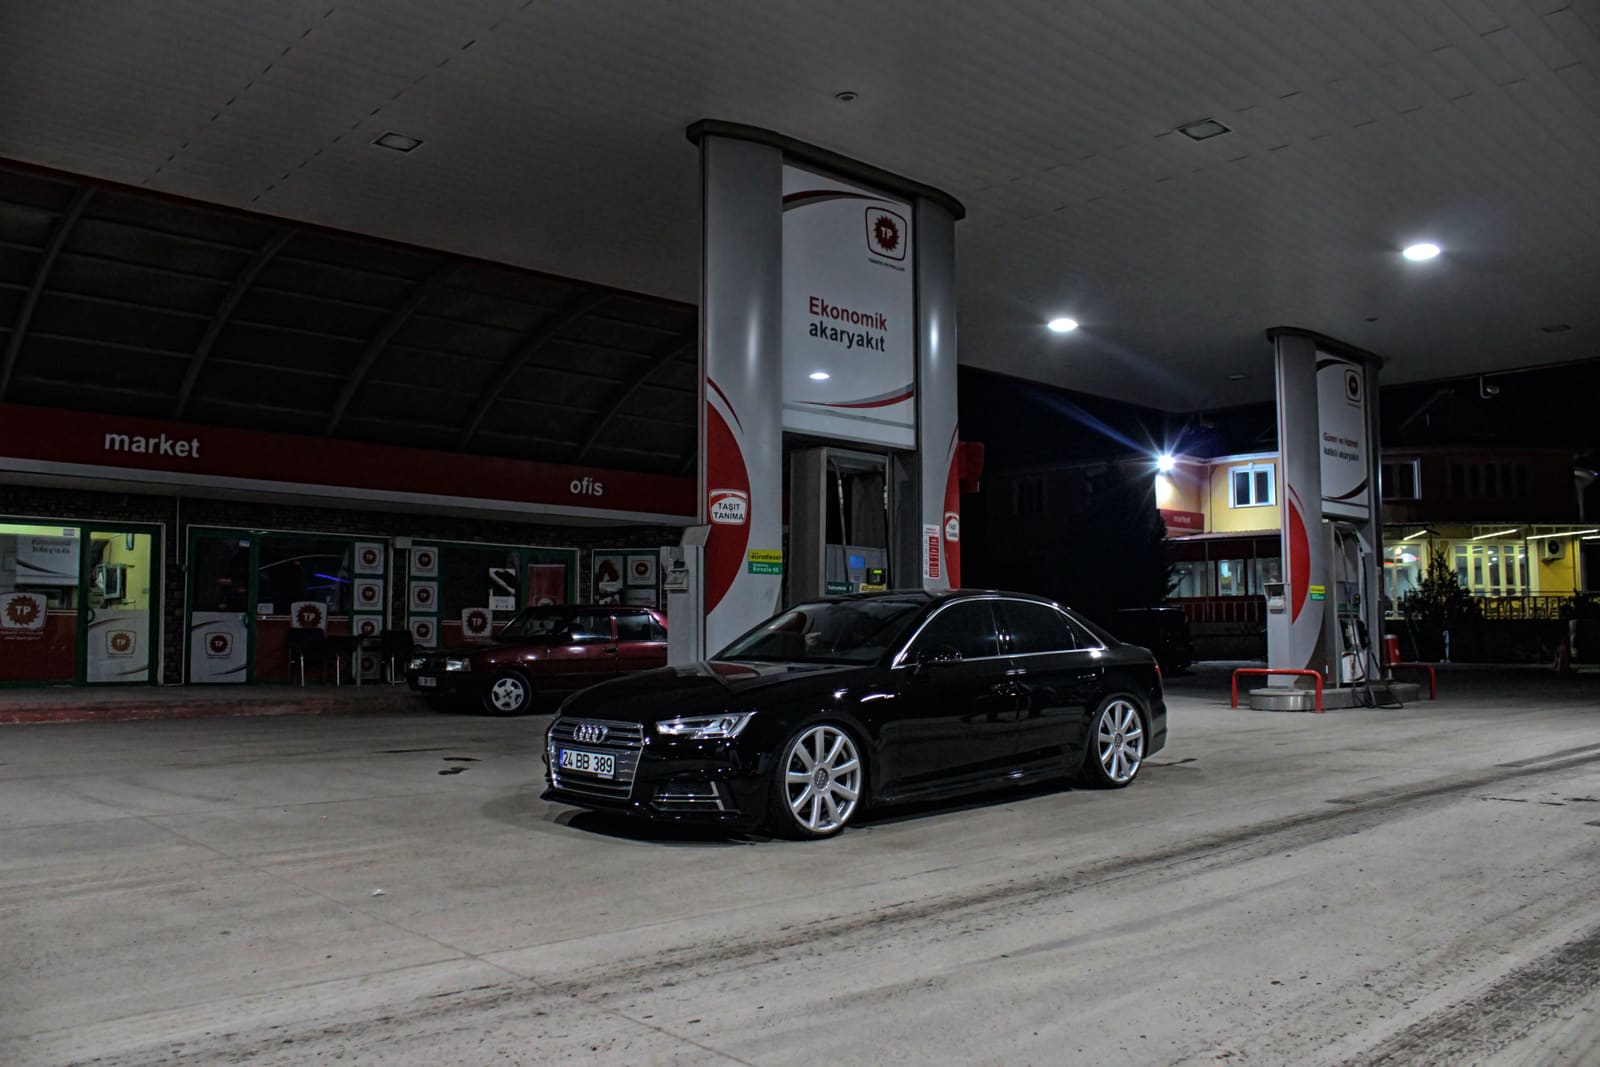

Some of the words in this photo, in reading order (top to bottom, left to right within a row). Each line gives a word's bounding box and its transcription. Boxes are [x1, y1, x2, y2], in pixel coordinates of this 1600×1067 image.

[880, 226, 893, 239] TP
[809, 296, 887, 331] Ekonomik
[809, 321, 886, 352] akaryakıt
[104, 432, 200, 459] market
[569, 476, 604, 497] ofis
[718, 503, 741, 511] TAŞIT
[713, 511, 744, 520] TANIMA
[15, 605, 32, 616] TP
[303, 612, 316, 622] TP
[471, 617, 482, 626] TP
[563, 751, 573, 768] 24
[576, 753, 590, 769] BB
[593, 756, 612, 773] 389
